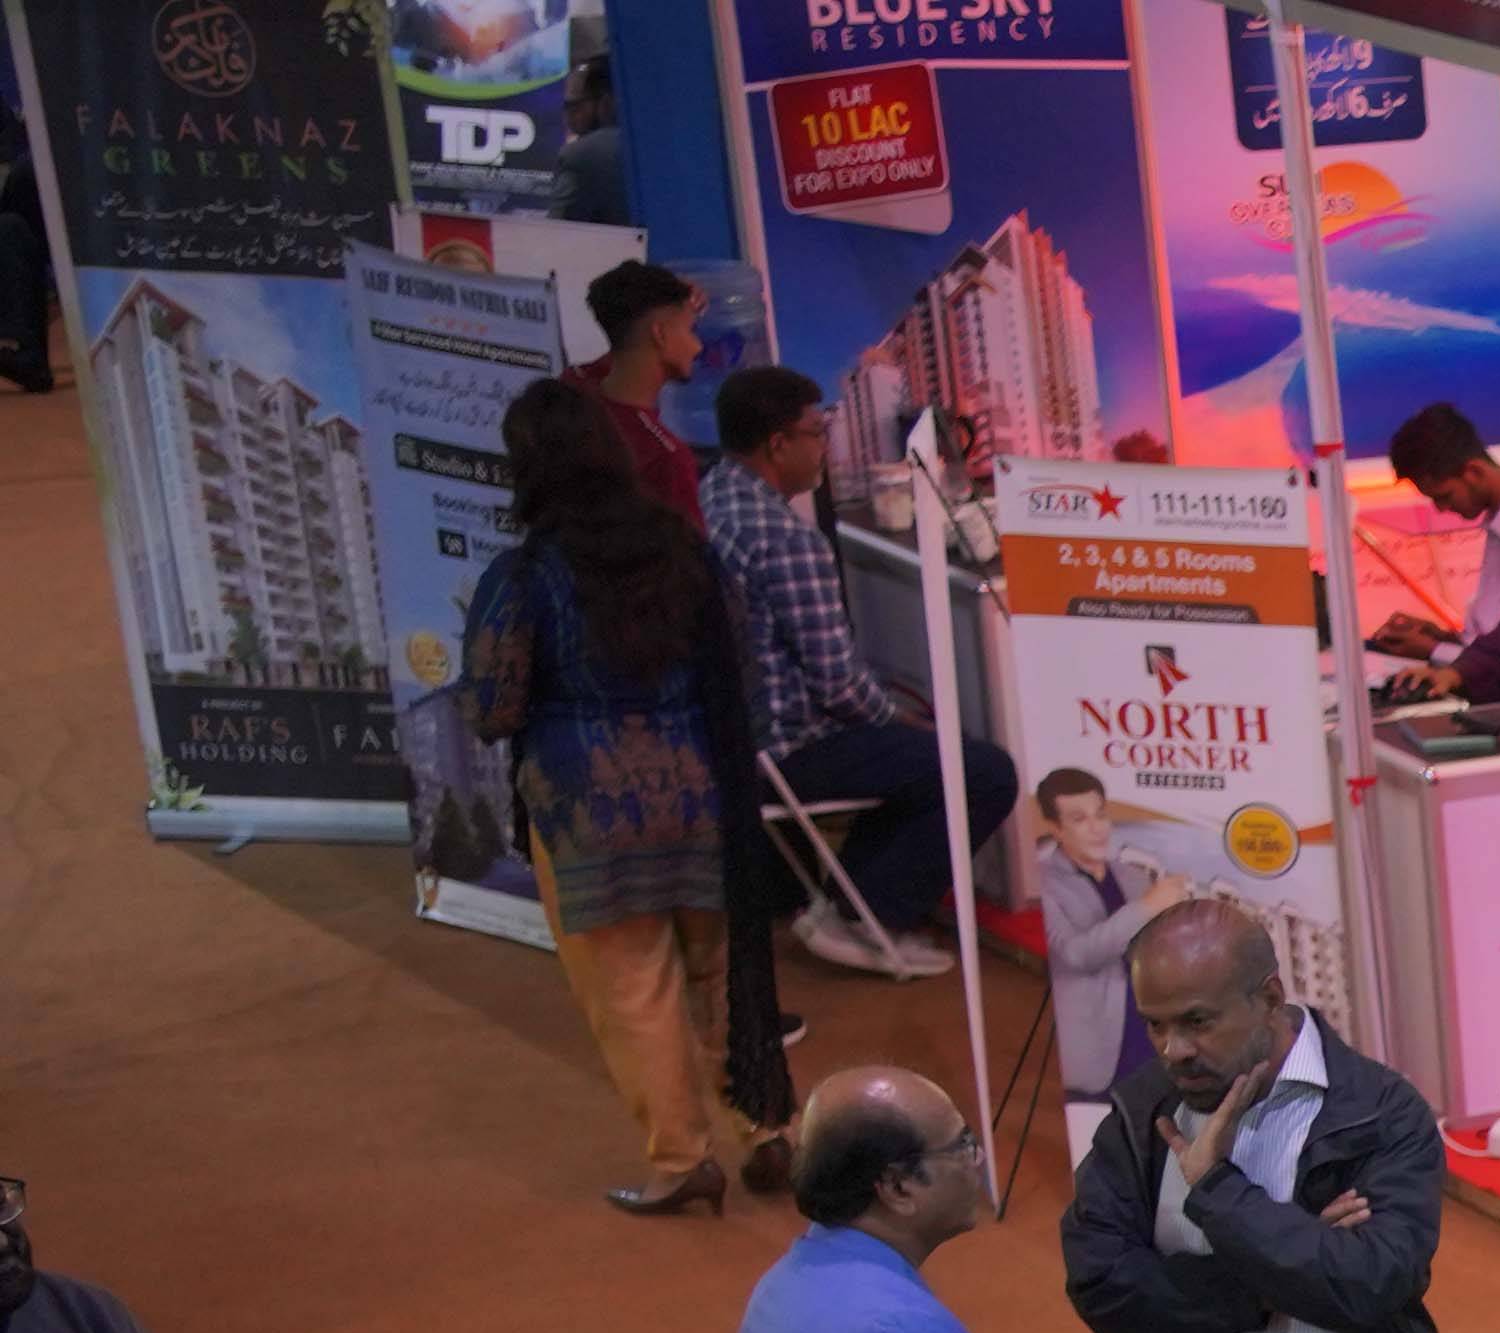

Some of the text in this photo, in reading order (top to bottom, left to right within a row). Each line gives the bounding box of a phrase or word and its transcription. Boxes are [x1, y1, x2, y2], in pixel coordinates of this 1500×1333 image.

[811, 16, 1054, 52] RESIDENCY
[828, 83, 873, 109] FLAT
[75, 103, 361, 151] FALAKNAZ
[425, 104, 536, 166] TDP
[801, 101, 912, 148] 10 LAC
[103, 146, 347, 184] GREENS
[815, 136, 906, 170] DISCOUNT
[1028, 491, 1288, 520] STAR 111-111-160
[1058, 543, 1081, 567] 2,
[1085, 544, 1107, 569] 3,
[1111, 545, 1126, 566] 4
[1132, 545, 1150, 568] &
[1175, 547, 1257, 573] Rooms
[1095, 570, 1228, 597] Apartments
[1076, 698, 1270, 745] NORTH
[178, 742, 309, 765] HOLDING
[1103, 739, 1252, 772] CORNER
